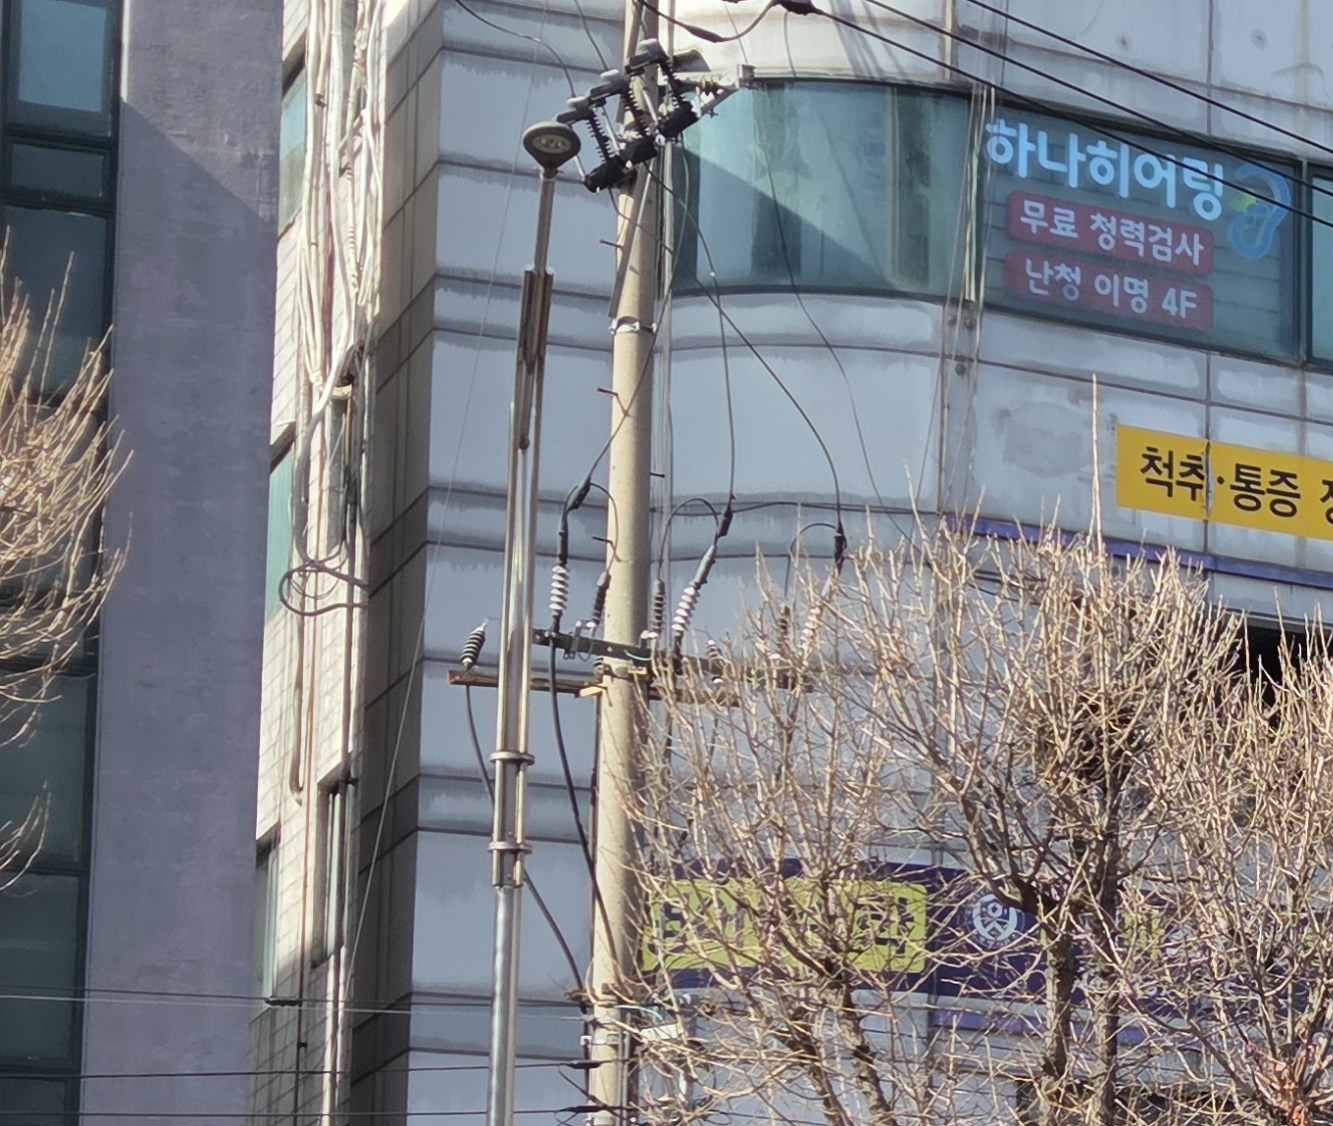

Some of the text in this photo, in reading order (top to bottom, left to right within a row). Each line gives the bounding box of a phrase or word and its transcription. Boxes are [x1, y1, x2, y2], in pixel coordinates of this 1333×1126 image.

[985, 118, 1226, 222] 하나히어링
[1018, 199, 1205, 268] 무료 청력검사
[1025, 258, 1198, 316] 난청 이명 4F
